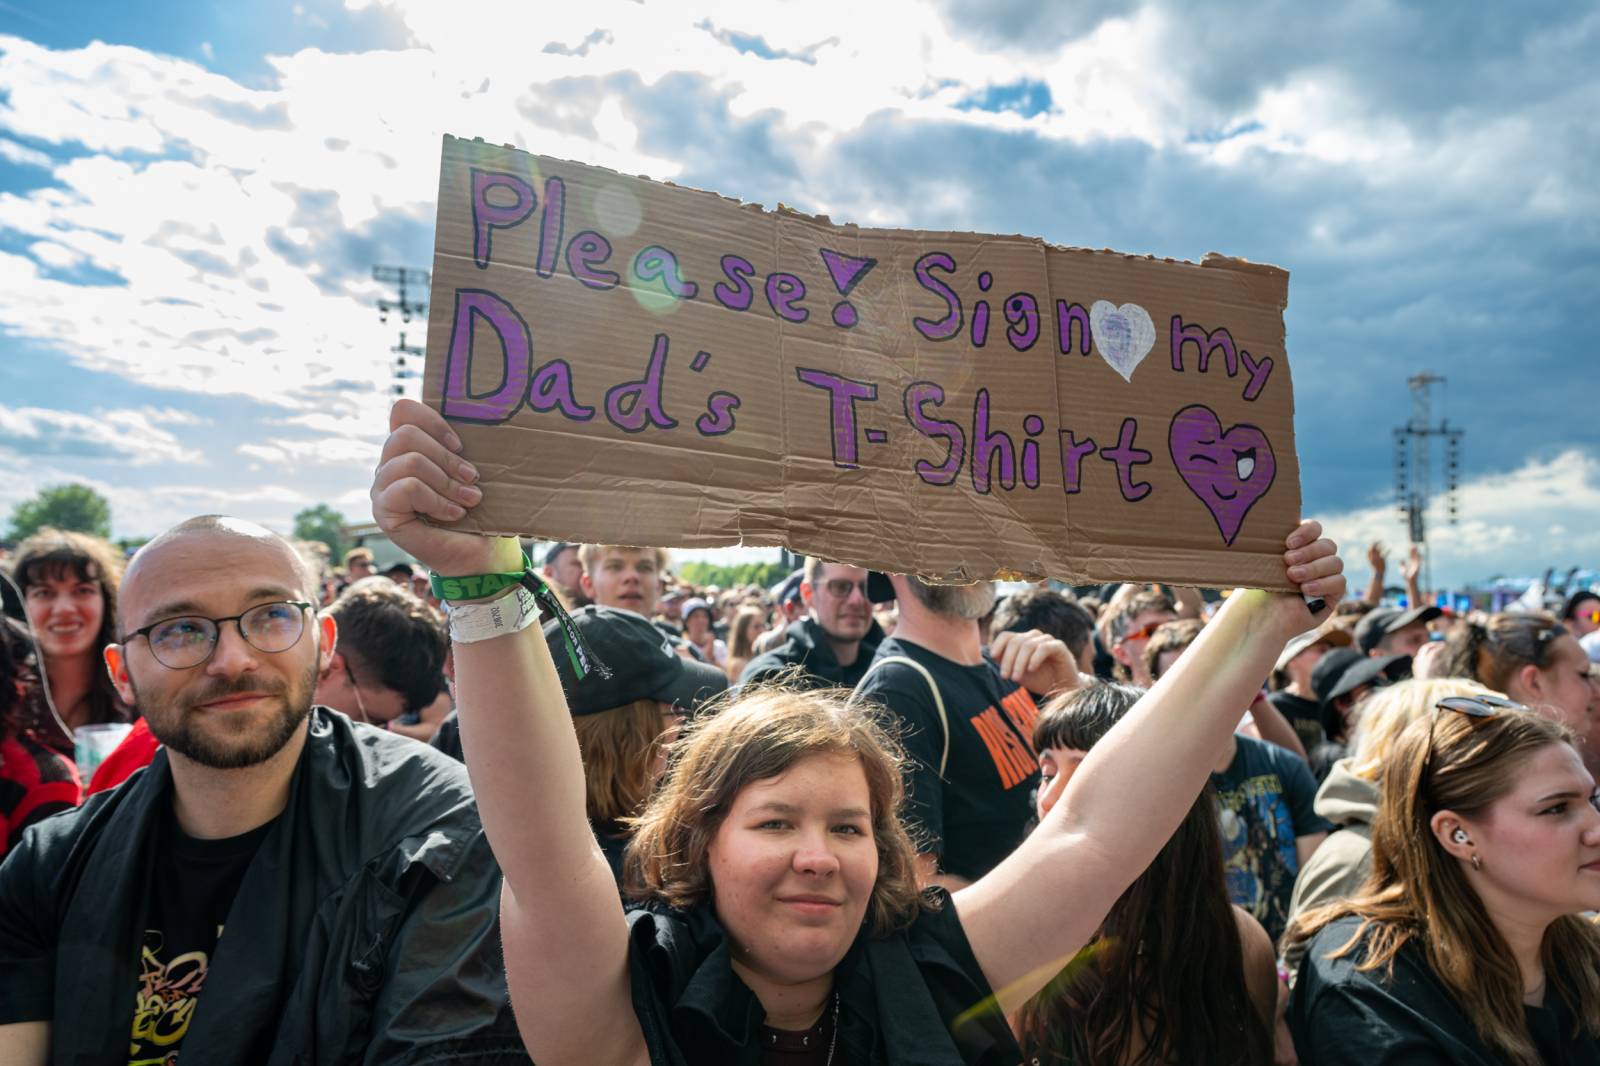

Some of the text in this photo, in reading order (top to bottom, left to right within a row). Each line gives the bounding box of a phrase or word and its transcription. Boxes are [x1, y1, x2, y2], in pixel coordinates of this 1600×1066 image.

[441, 288, 741, 437] Dad's
[470, 167, 1274, 401] Please! Sign my
